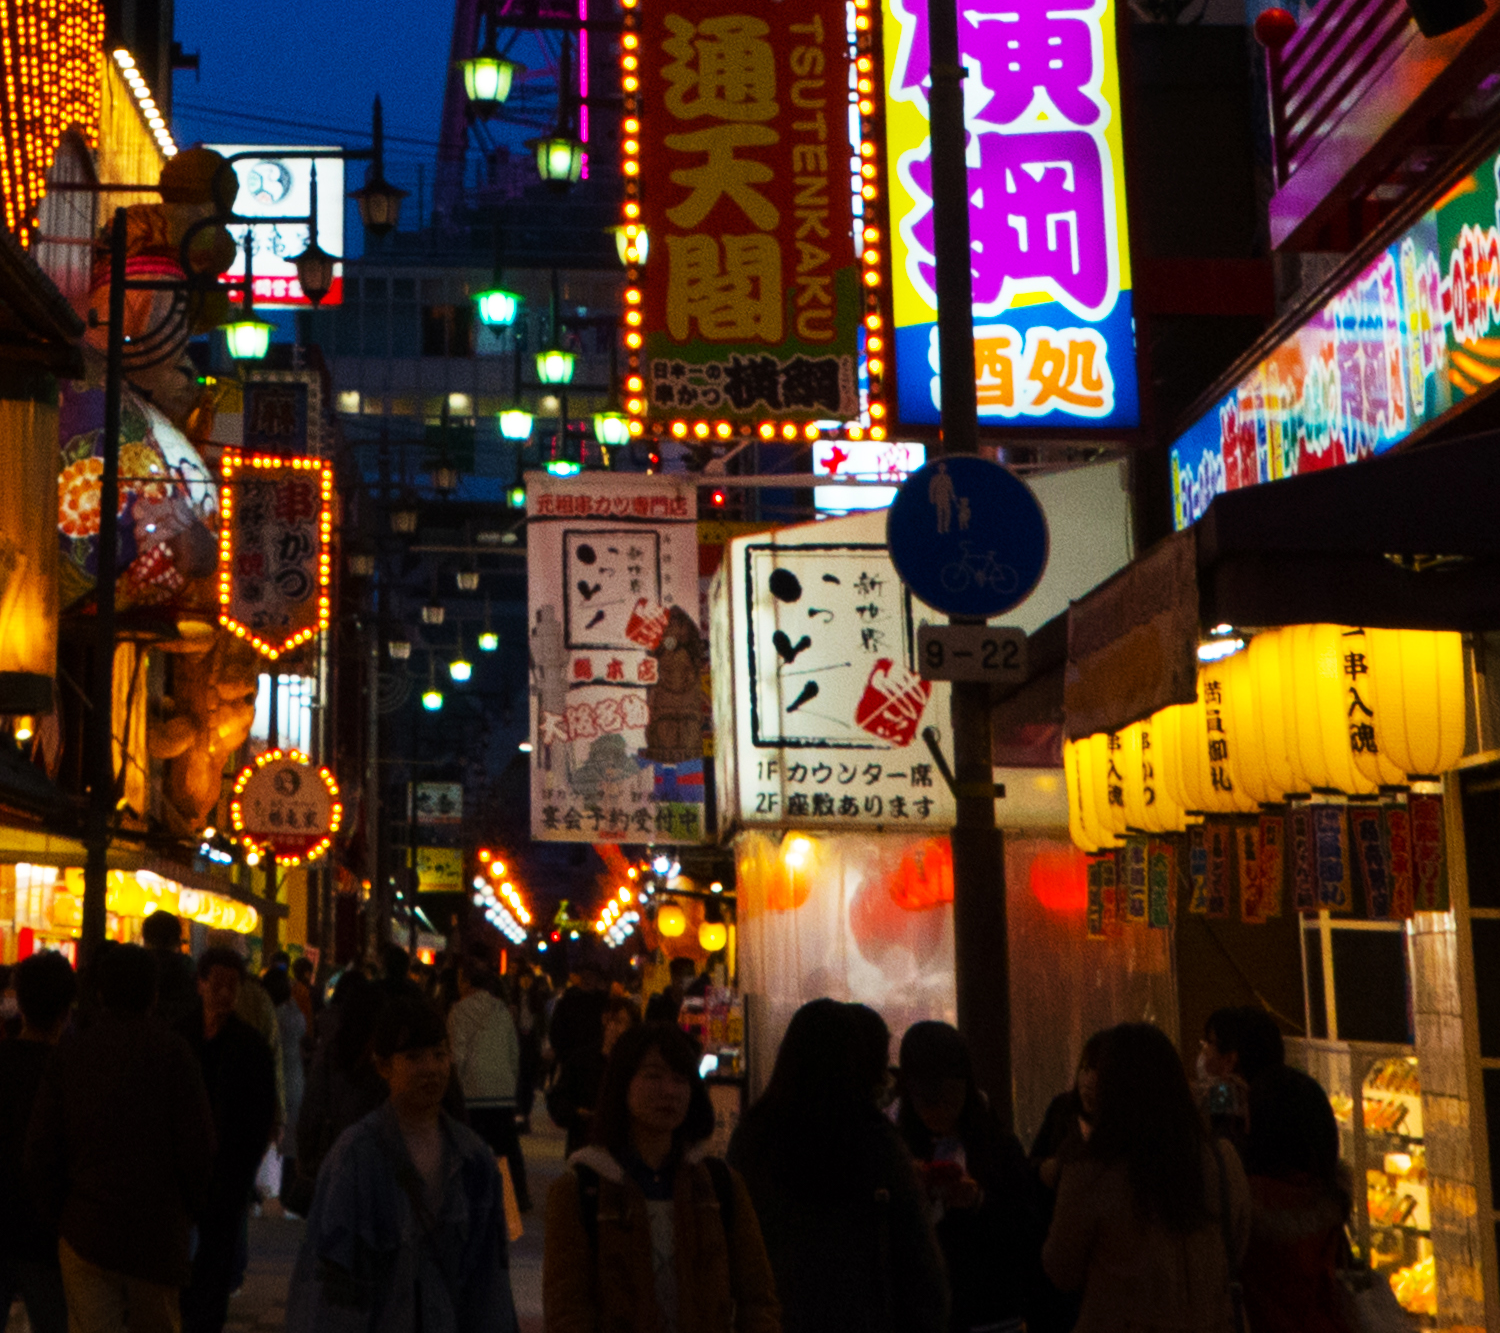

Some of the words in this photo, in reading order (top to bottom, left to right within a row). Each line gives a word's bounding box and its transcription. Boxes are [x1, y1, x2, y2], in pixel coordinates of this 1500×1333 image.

[661, 12, 785, 345] 通天閣
[787, 14, 835, 343] TSUTENKAKU
[653, 362, 721, 383] 日本一の
[724, 355, 842, 411] 横綱
[653, 384, 721, 408] 串かつ
[536, 493, 688, 517] 元祖串カツ専門店
[756, 761, 778, 782] 1F
[787, 761, 934, 789] カウンター席
[541, 805, 698, 833] 宴会予約受付中
[755, 793, 779, 814] 2F
[787, 793, 935, 819] 座敷あります
